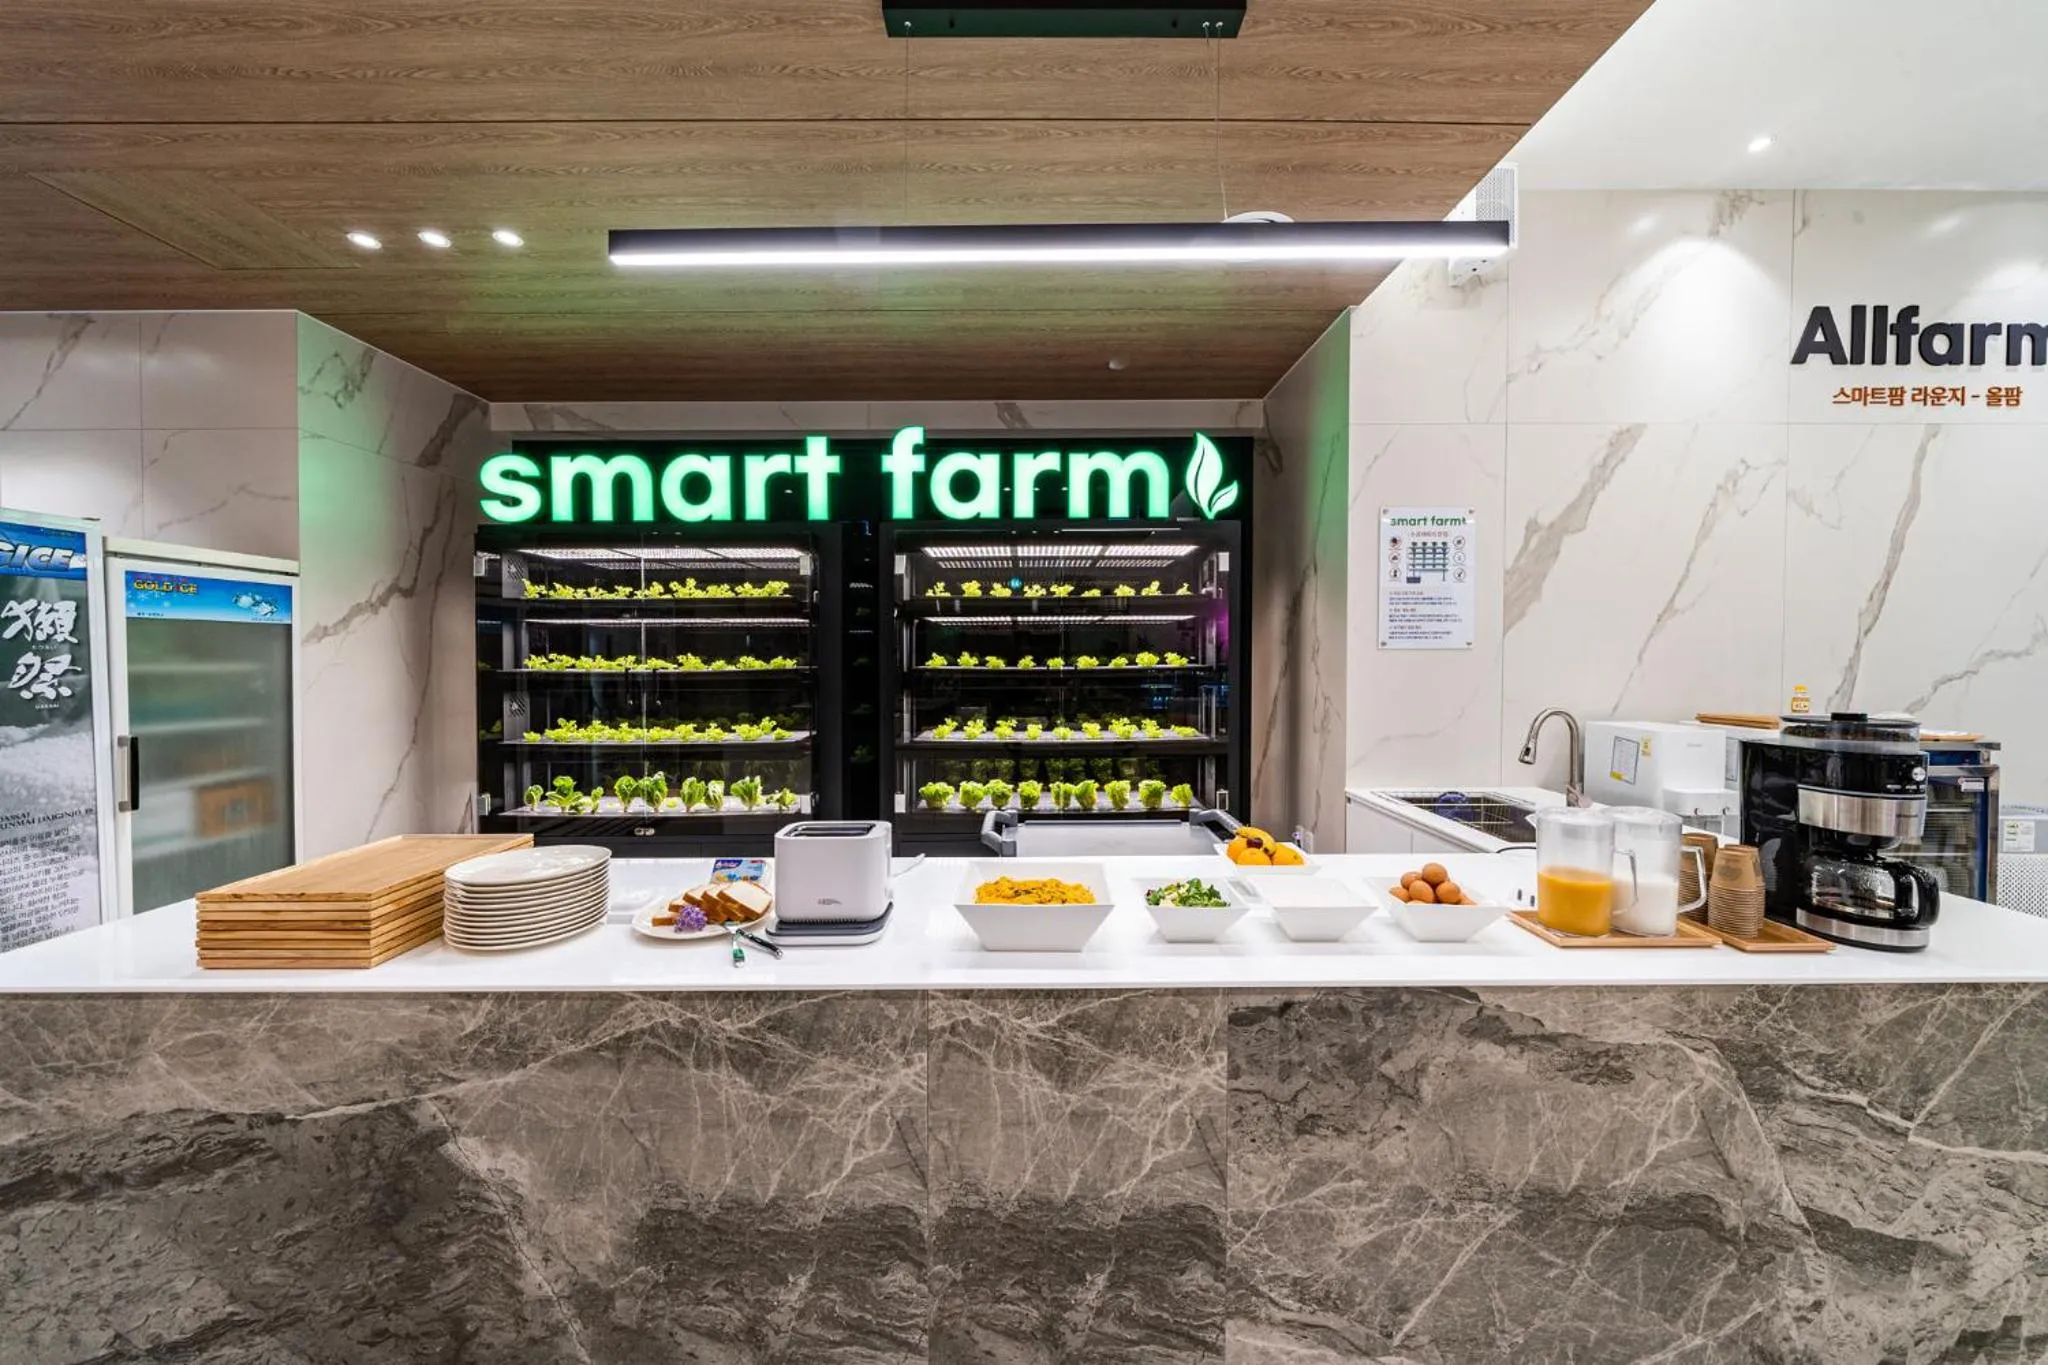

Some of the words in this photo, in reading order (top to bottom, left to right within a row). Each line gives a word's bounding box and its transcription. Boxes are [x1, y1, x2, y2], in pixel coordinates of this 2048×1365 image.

[1790, 304, 2048, 366] Allfarm
[1832, 386, 1906, 407] 스마트팜
[1911, 386, 1966, 407] 라운지
[1985, 386, 2023, 407] 올팜
[479, 435, 841, 522] smart
[881, 426, 1171, 520] farm
[1390, 516, 1427, 526] smart
[1430, 515, 1461, 526] farm
[133, 579, 173, 594] GOLD
